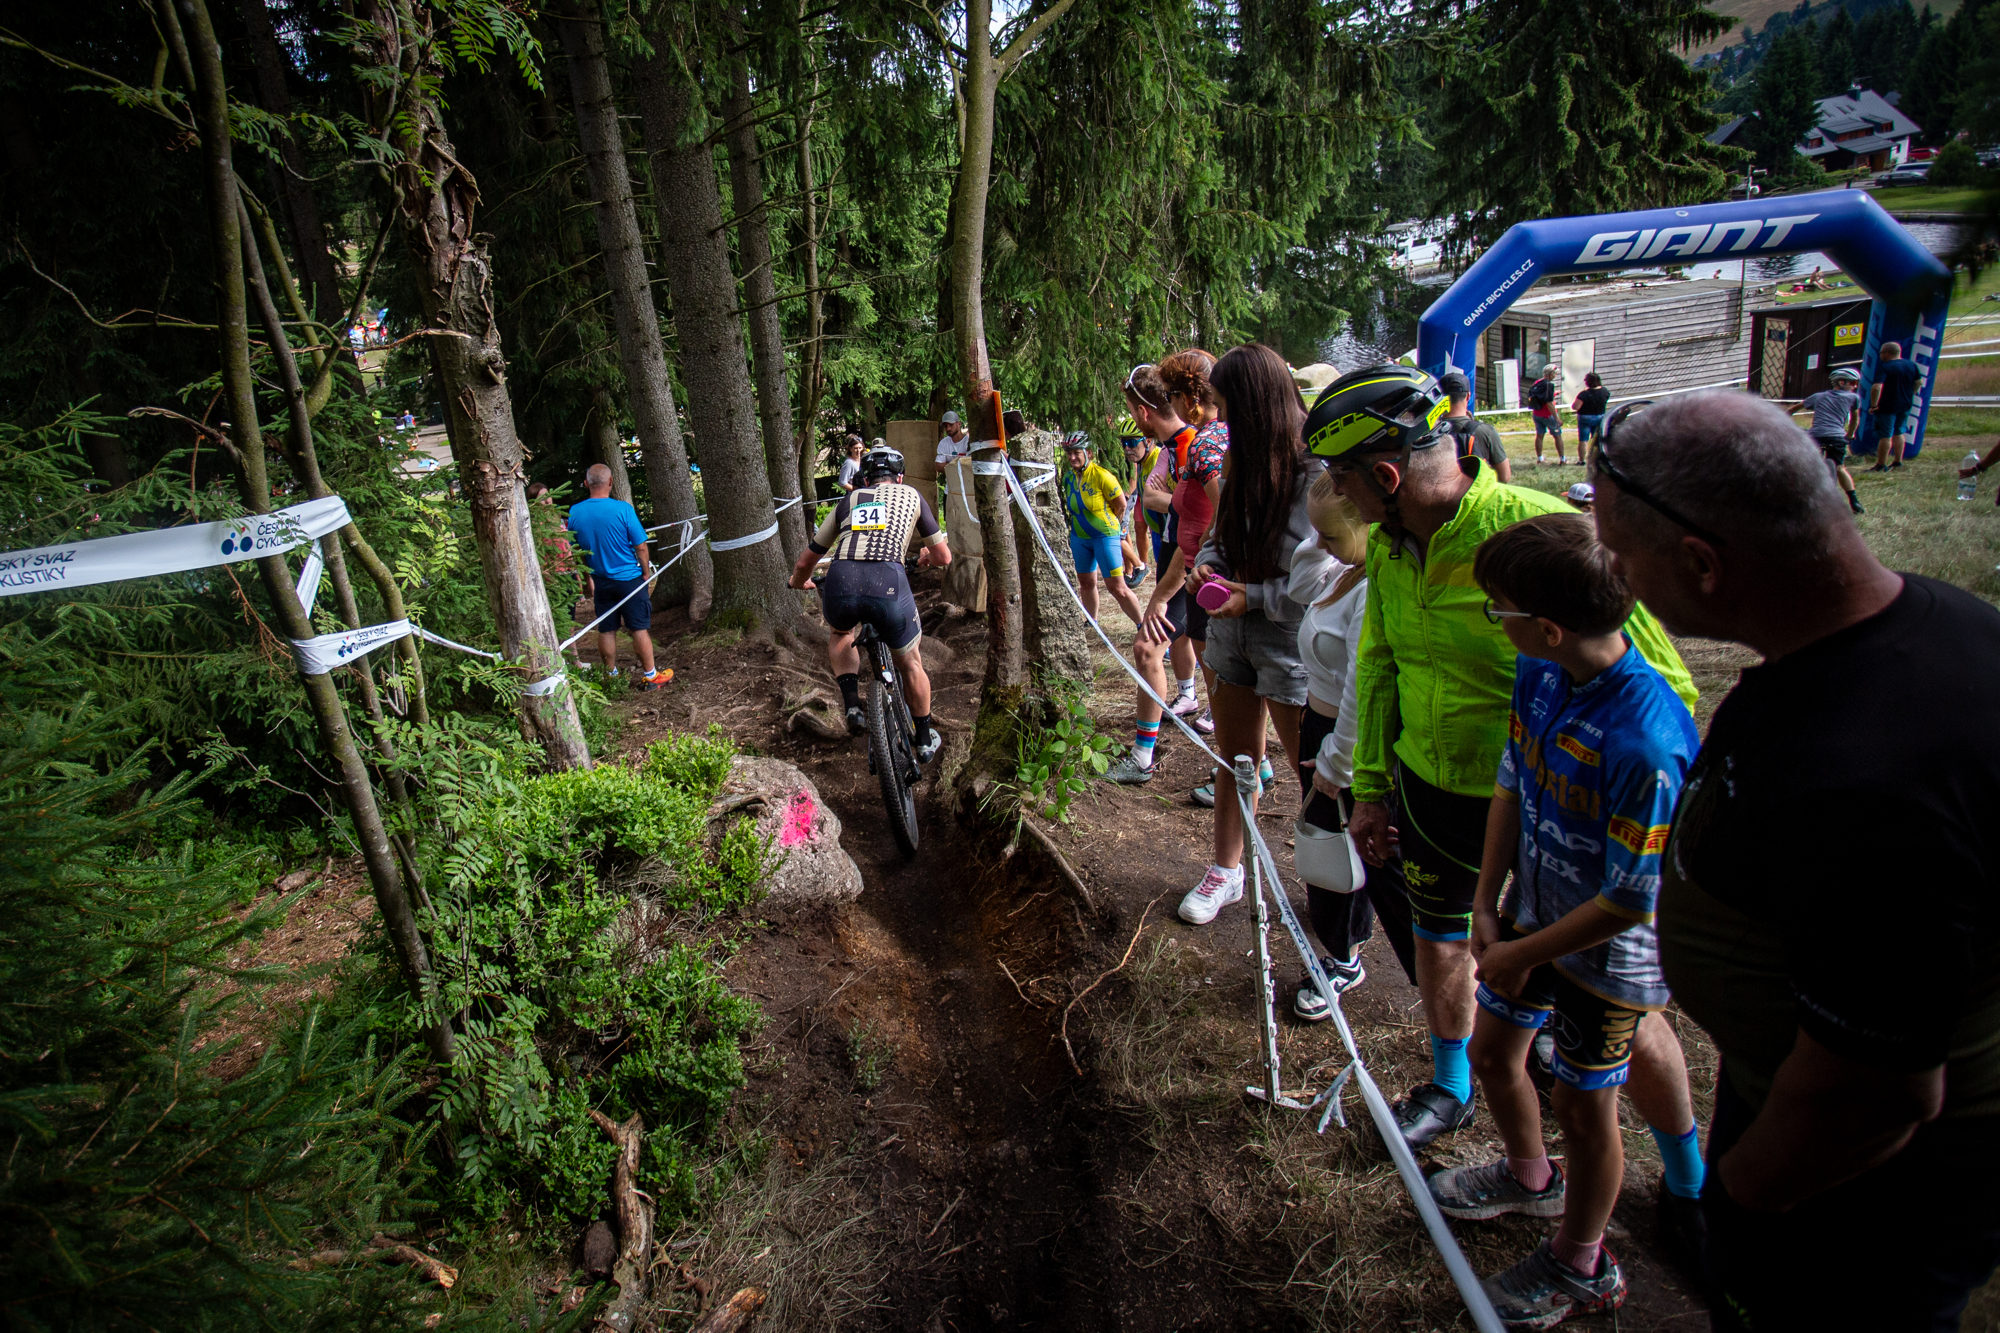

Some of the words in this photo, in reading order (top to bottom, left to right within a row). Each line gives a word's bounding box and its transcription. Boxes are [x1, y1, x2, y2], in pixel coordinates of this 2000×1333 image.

[1574, 213, 1821, 265] GIANT
[1463, 258, 1535, 327] GIANT-BICYCLES.CZ
[858, 508, 880, 524] 34
[33, 550, 76, 566] SVAZ
[0, 566, 66, 587] KLISTIKY
